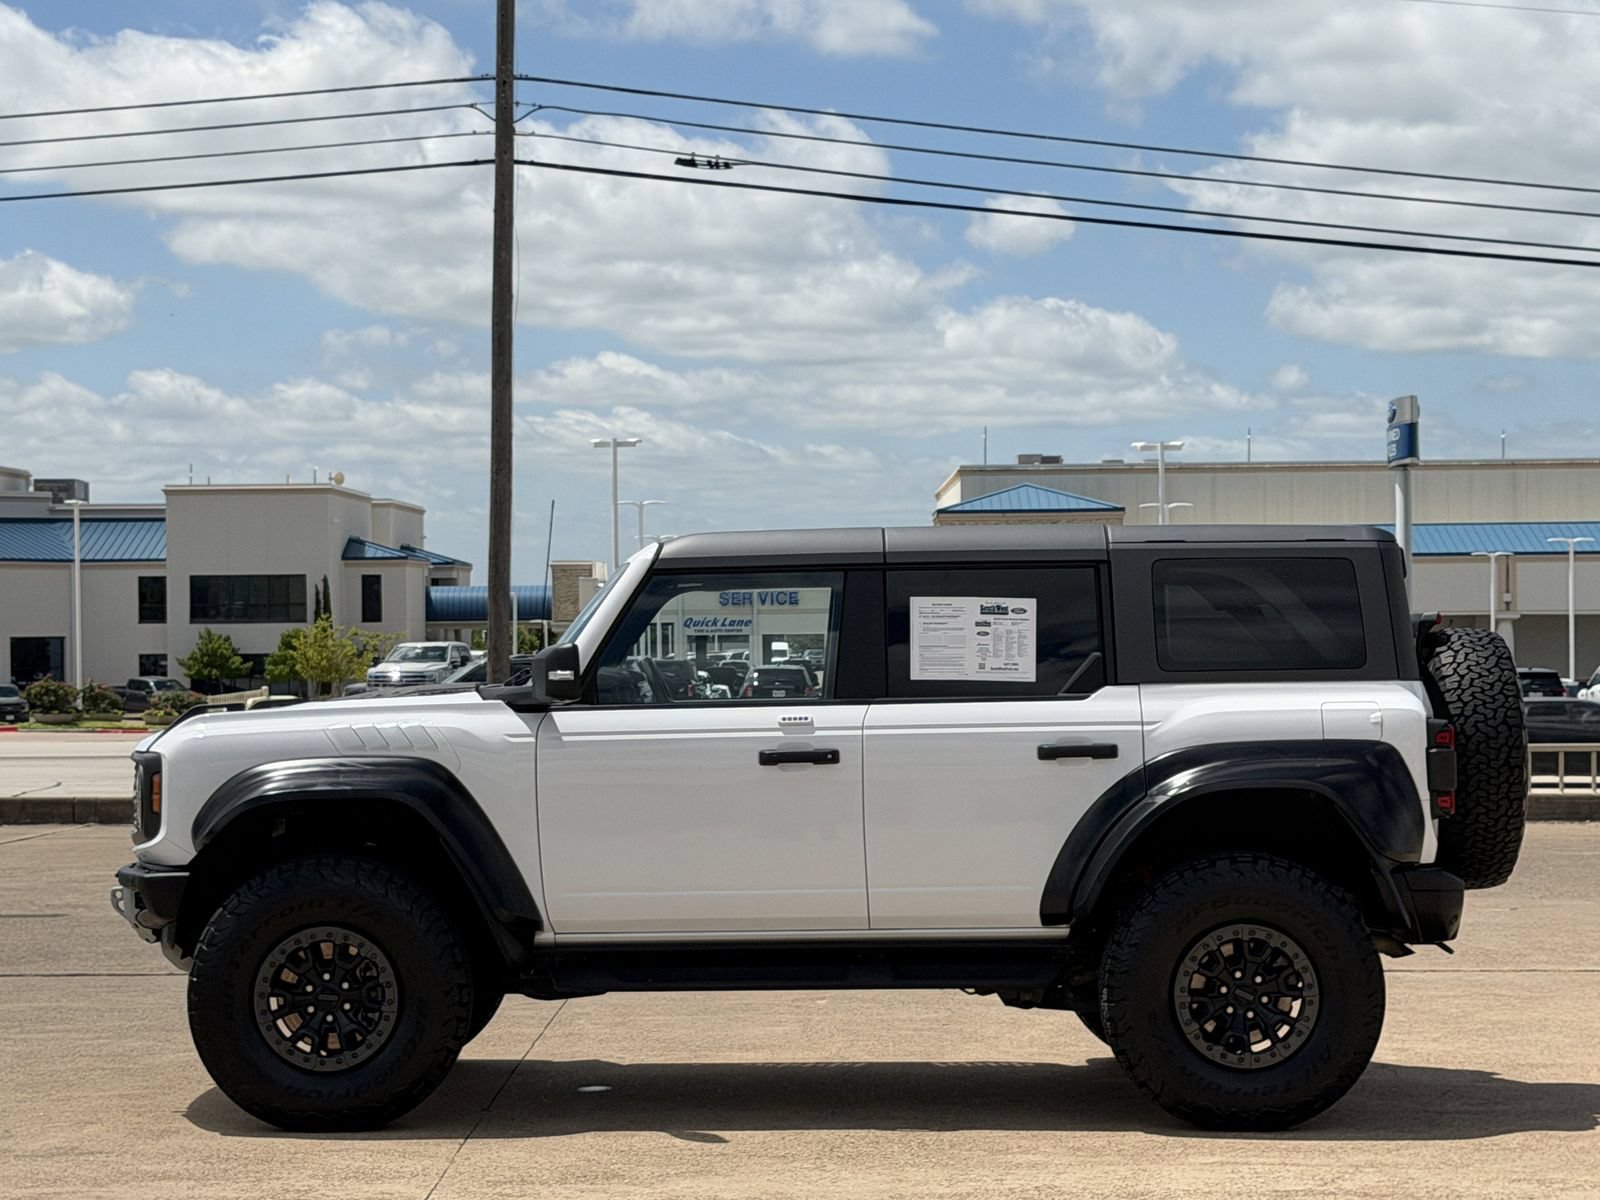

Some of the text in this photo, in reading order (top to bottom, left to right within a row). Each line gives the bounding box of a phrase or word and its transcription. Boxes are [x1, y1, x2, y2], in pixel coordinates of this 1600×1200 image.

[719, 591, 799, 606] SERVICE
[684, 617, 752, 628] Quick Lane
